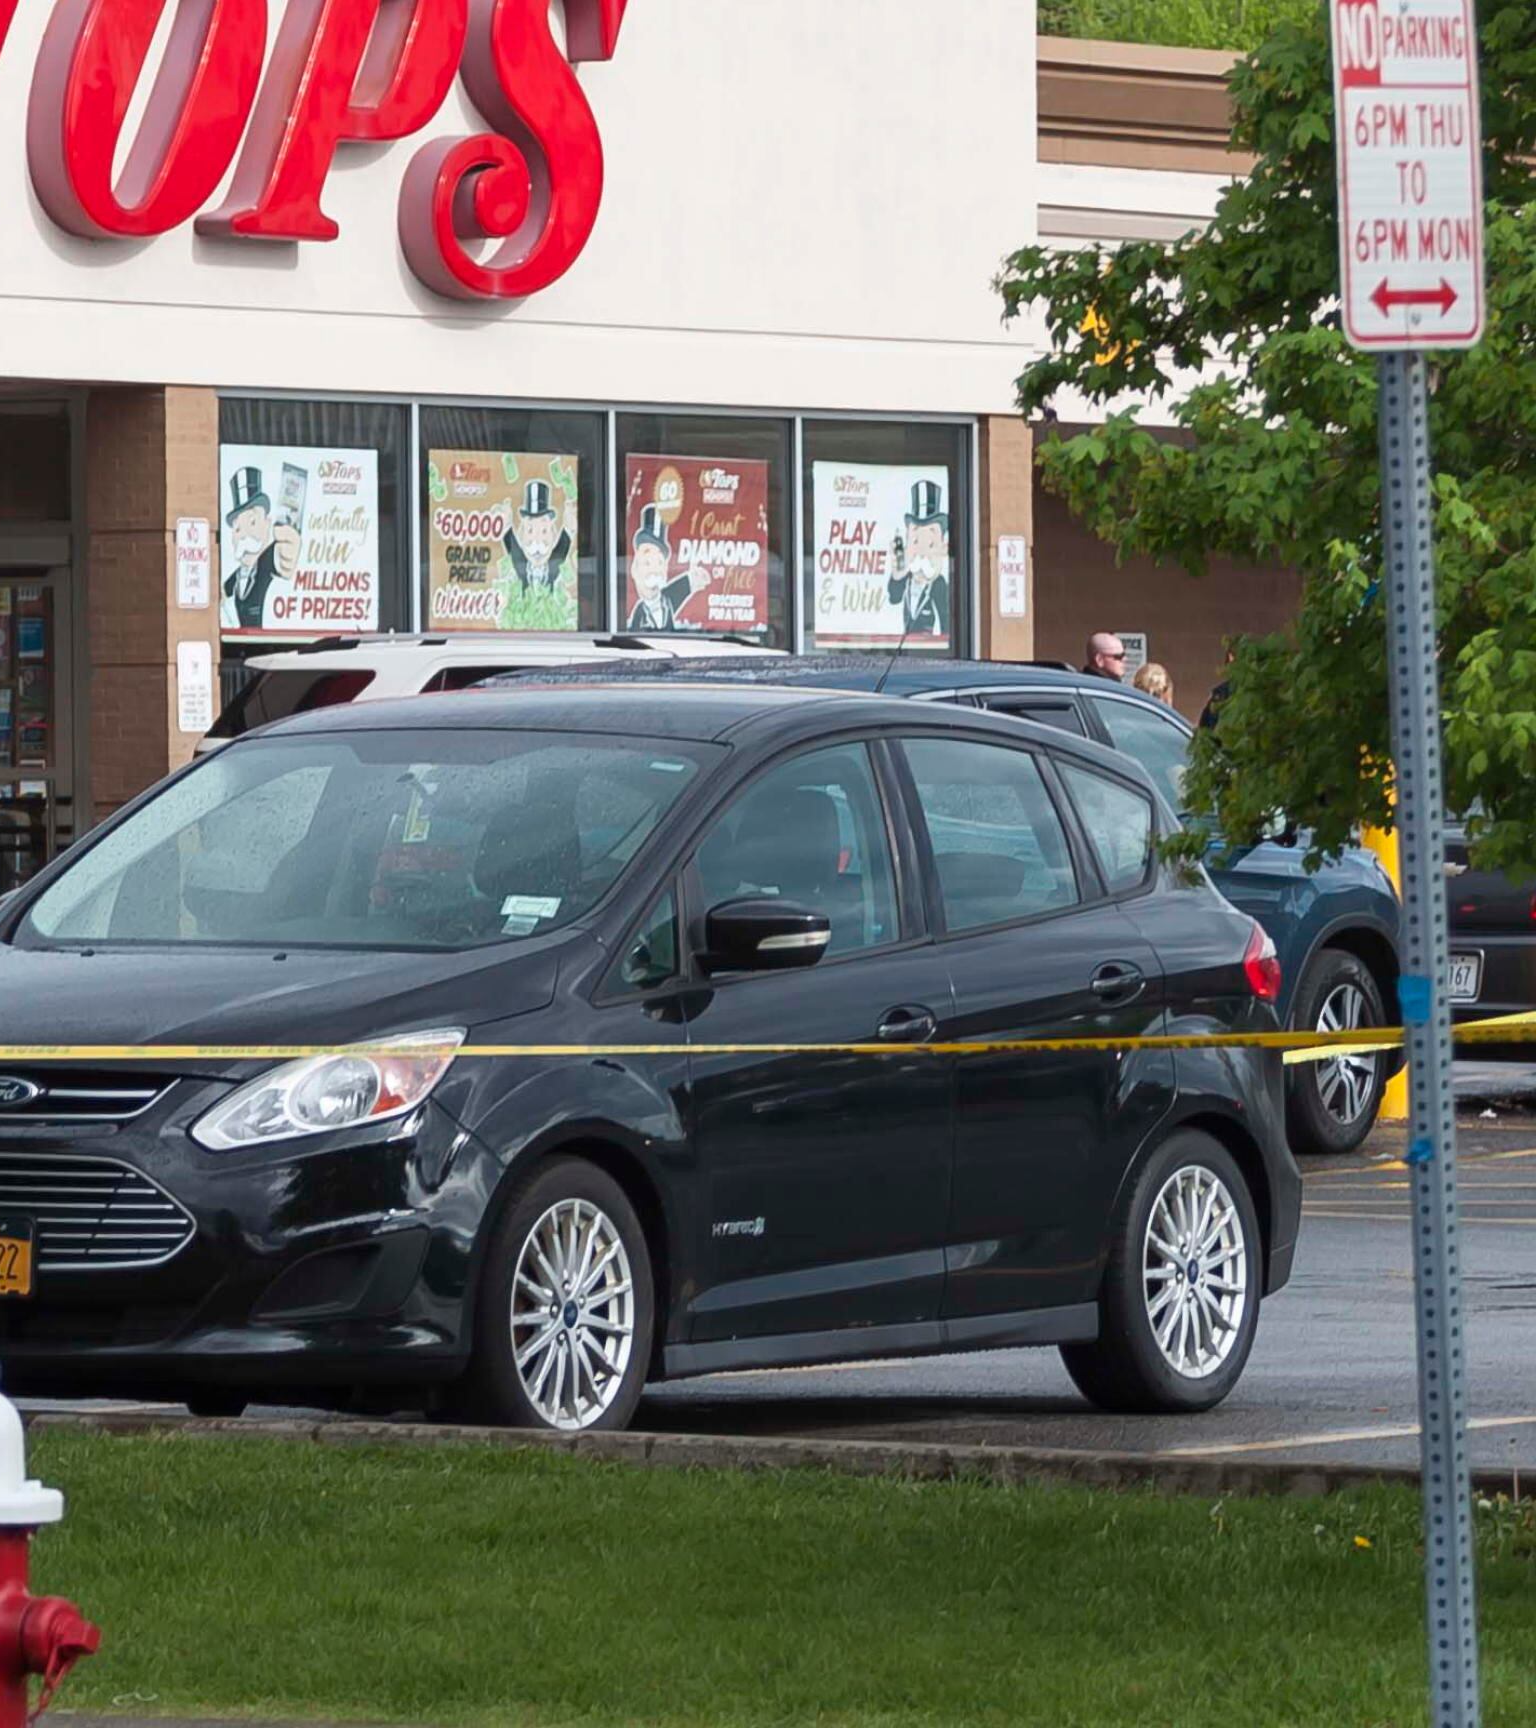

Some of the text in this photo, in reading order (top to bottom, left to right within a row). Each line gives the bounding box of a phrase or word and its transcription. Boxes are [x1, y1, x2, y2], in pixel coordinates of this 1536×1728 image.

[1339, 3, 1463, 70] NO PARKING
[1354, 104, 1463, 147] 6PM THU
[1396, 161, 1426, 204] TO
[1355, 219, 1470, 262] 6PM MON
[436, 511, 504, 541] $60,000
[829, 519, 876, 545] PLAY
[445, 545, 491, 563] GRAND
[677, 538, 761, 566] DIAMOND
[819, 548, 887, 575] ONLINE
[294, 570, 371, 592] MILLIONS
[448, 565, 487, 583] PRIZE
[273, 597, 371, 620] OF PRIZES!
